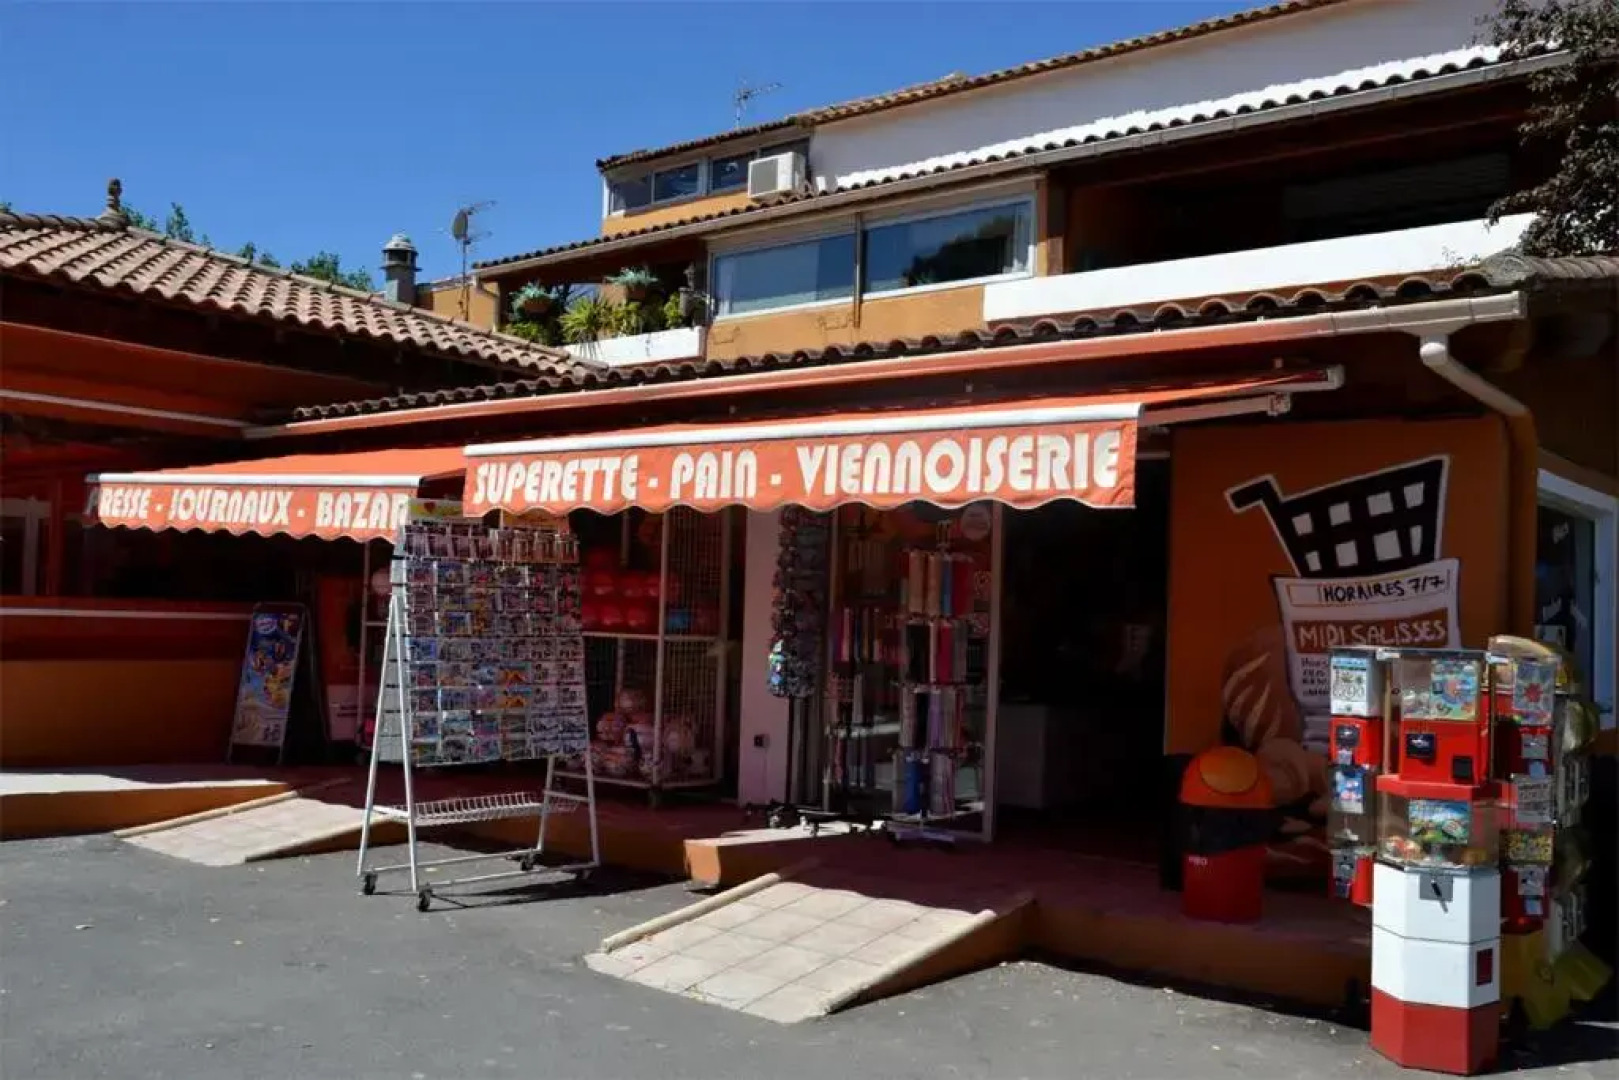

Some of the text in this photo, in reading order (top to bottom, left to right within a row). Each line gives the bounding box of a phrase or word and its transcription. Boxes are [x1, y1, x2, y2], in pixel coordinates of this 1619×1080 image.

[473, 456, 638, 505] SUPERETTE
[669, 450, 758, 500] PAIN
[796, 431, 1121, 496] VIENNOISERIE
[168, 488, 293, 525] JOURNAUX
[314, 491, 410, 529] BAZAR
[1323, 575, 1446, 602] HORAIRES 7/7
